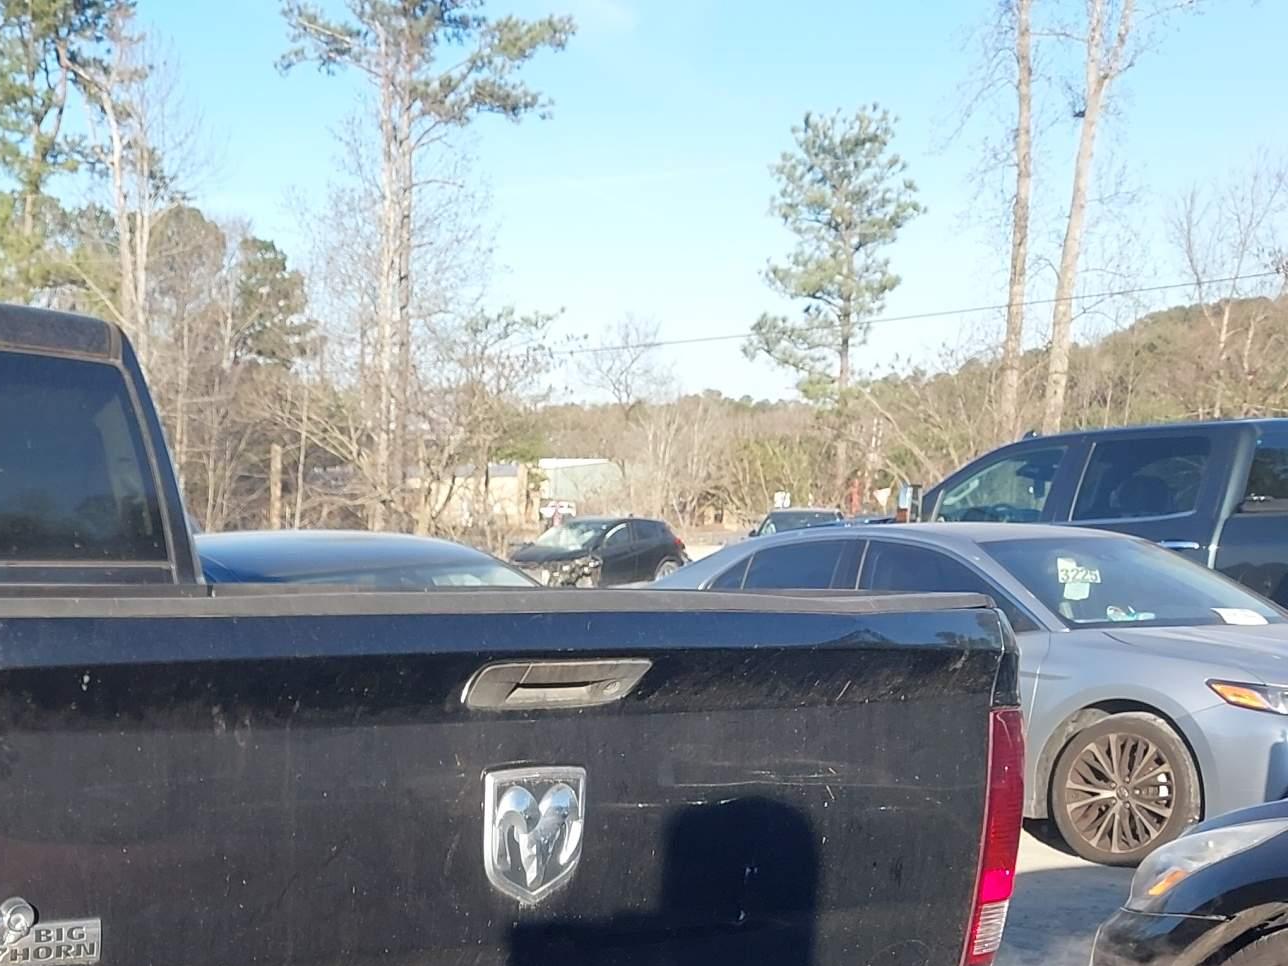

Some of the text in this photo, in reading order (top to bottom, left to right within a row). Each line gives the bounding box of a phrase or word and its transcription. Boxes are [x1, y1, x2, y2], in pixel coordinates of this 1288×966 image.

[1060, 568, 1098, 582] 3225
[34, 926, 86, 943] BIG
[10, 943, 96, 962] HORN
